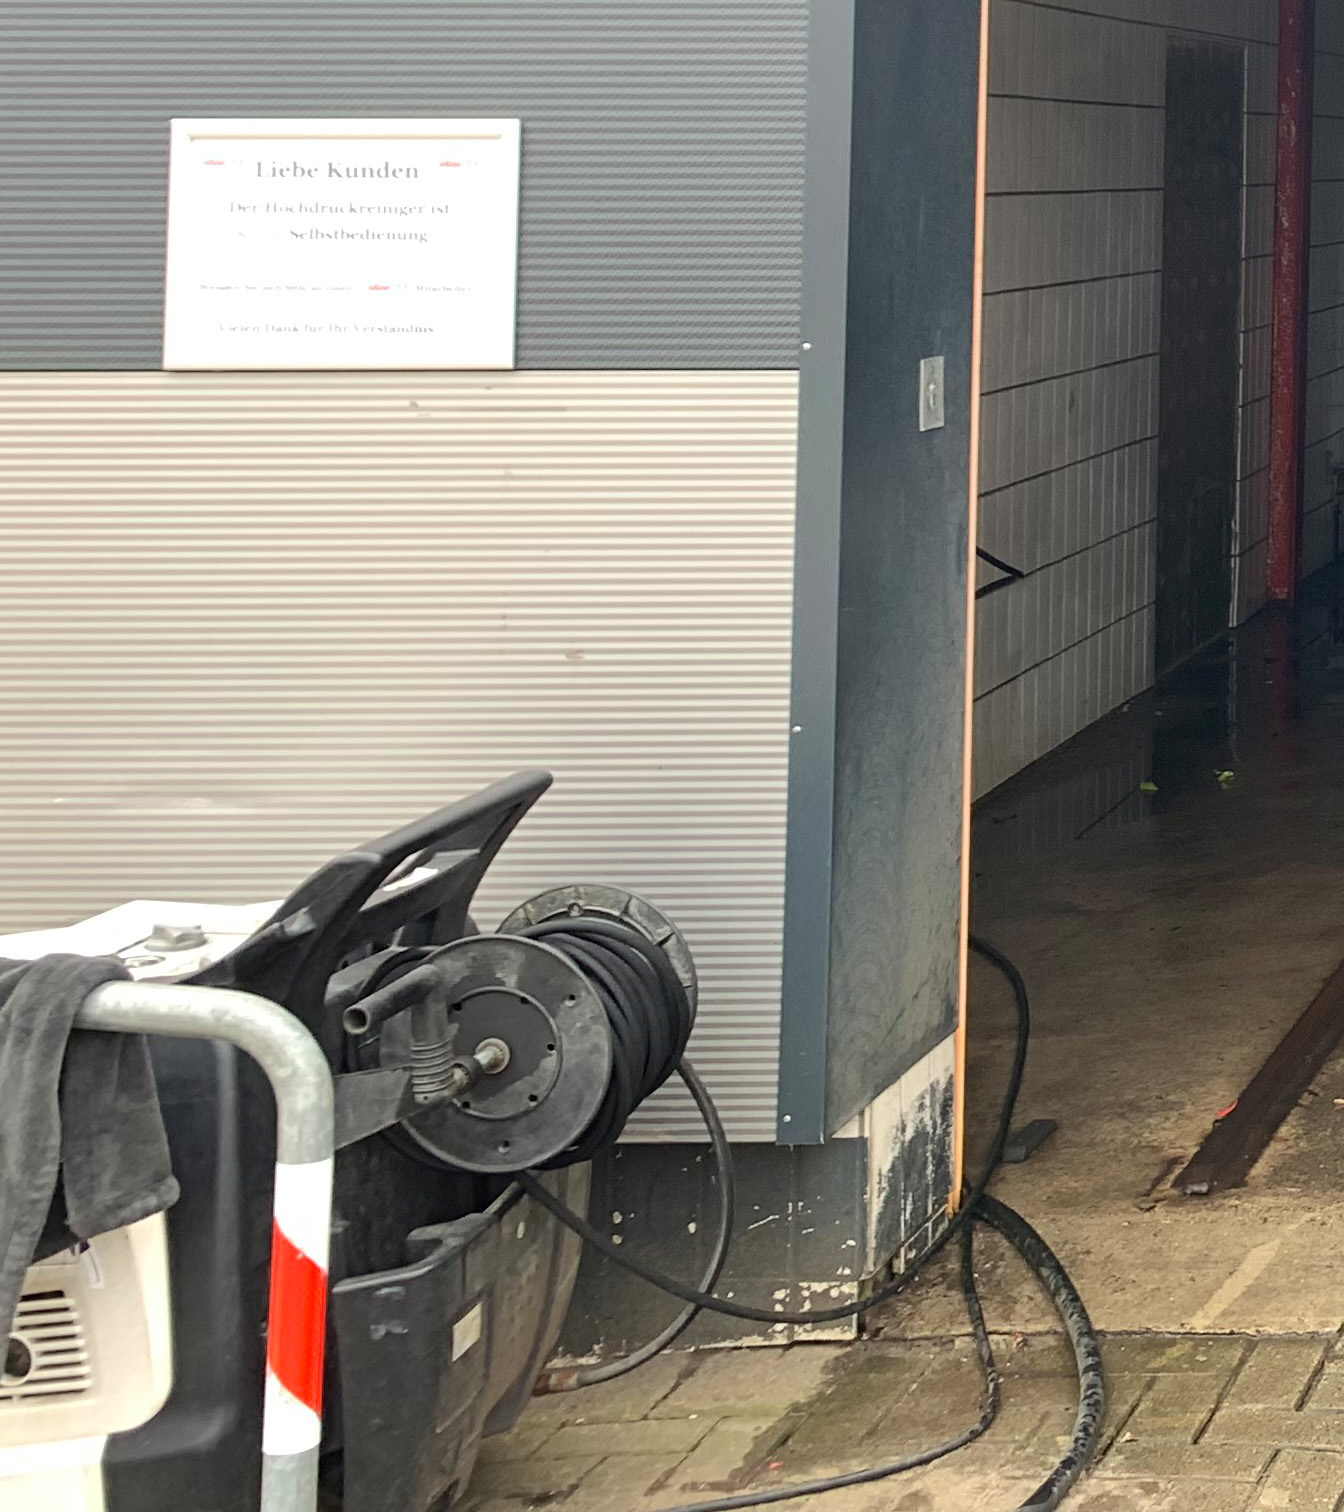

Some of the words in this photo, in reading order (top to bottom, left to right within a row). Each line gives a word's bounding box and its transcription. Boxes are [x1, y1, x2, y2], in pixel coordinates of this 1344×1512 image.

[256, 160, 319, 179] Liebe
[327, 160, 420, 180] Kunden
[289, 226, 430, 244] Selbstbedienung
